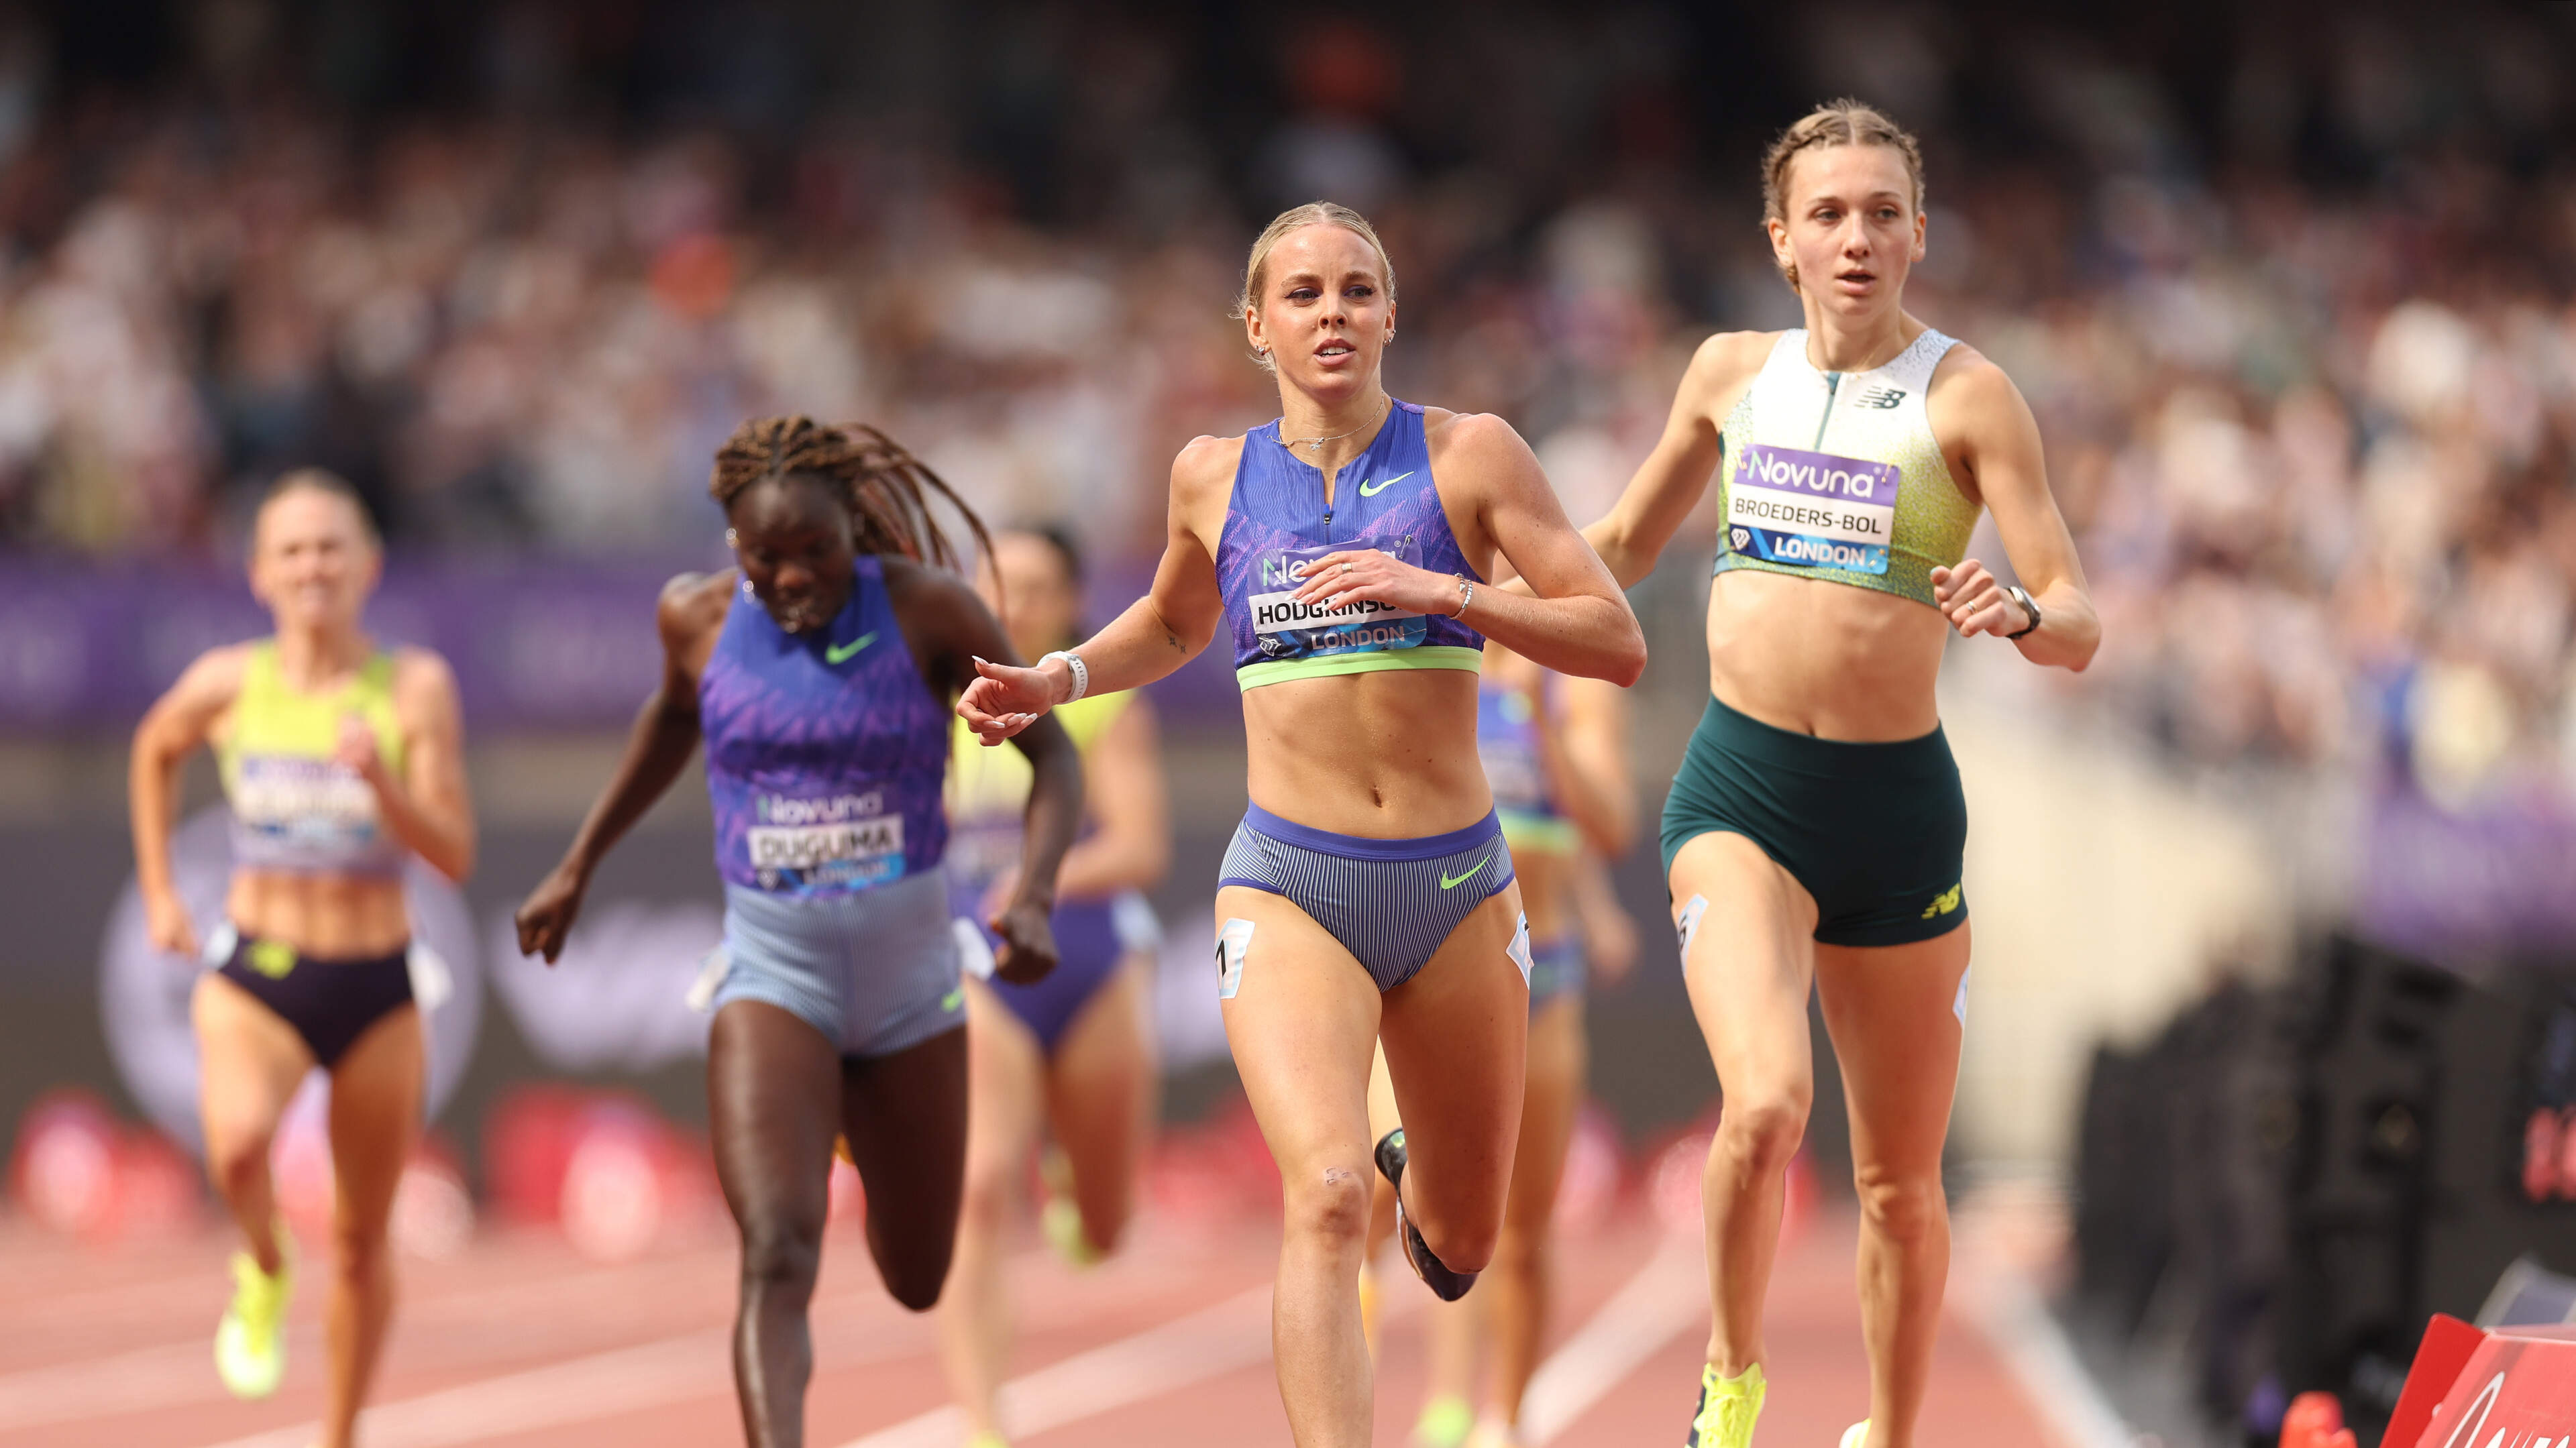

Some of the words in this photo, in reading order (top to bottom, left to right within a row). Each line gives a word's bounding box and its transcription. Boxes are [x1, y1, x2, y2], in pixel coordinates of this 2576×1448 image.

[1748, 451, 1874, 498] Novuna
[1735, 499, 1882, 534] BROEDERS-BOL
[1775, 537, 1865, 565] LONDON
[1259, 598, 1402, 624] HODGKINSO
[1311, 627, 1405, 650] LONDON
[757, 793, 883, 824] Novuna
